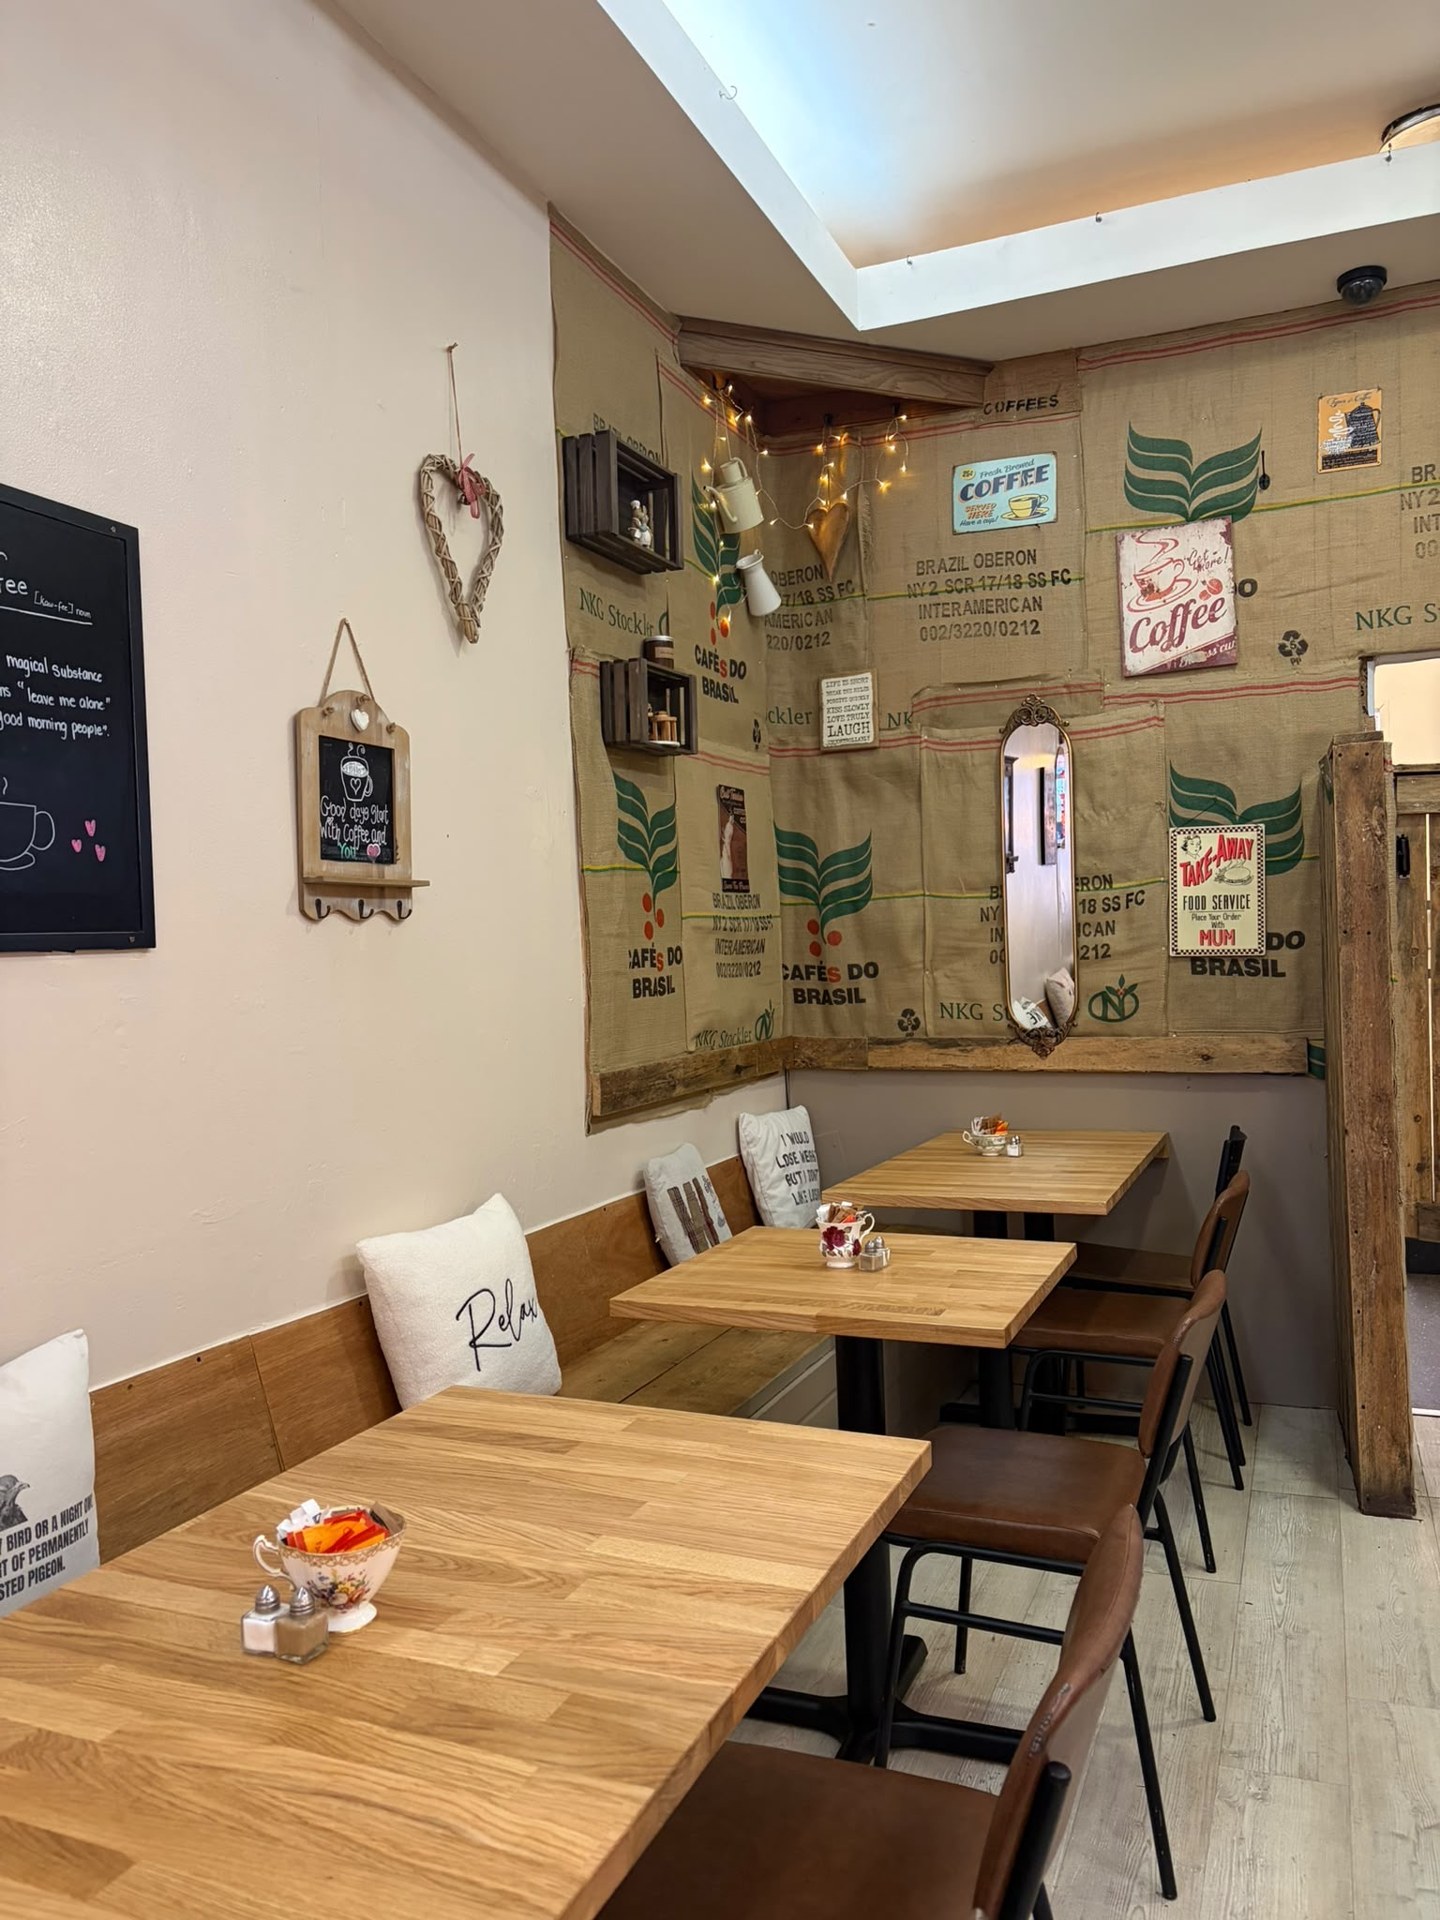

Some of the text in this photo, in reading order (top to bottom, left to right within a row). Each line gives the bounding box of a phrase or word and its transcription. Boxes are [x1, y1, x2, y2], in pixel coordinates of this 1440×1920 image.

[983, 395, 1059, 415] COFFEES
[980, 468, 1001, 479] Fresh
[1003, 459, 1034, 473] Brewed
[959, 464, 1050, 502] COFFEE
[916, 549, 1037, 576] BRAZIL OBERON
[770, 564, 823, 587] OBERON
[944, 576, 975, 596] SCR
[977, 572, 1023, 592] 17/18
[1027, 572, 1047, 589] SS
[1050, 568, 1072, 587] FC
[816, 585, 835, 602] SS
[837, 579, 855, 597] FC
[918, 596, 1043, 620] INTERAMERICAN
[1355, 603, 1440, 631] NKG S
[919, 619, 1041, 642] 002/3220/0212
[1130, 597, 1228, 654] Coffee
[6, 654, 48, 678] magical
[729, 658, 747, 680] DO
[702, 675, 739, 704] BRASIL
[59, 696, 76, 708] me
[826, 703, 870, 714] KISS SLOWLY
[766, 706, 812, 725] ckler
[827, 712, 870, 723] LOVE TRULY
[28, 717, 67, 740] morning
[827, 721, 870, 737] LAUGH
[320, 795, 346, 822] Good
[343, 823, 370, 851] Coffee
[371, 825, 387, 846] and
[340, 843, 356, 859] You
[1179, 834, 1254, 887] TAKE-AWAY
[1102, 895, 1121, 913] SS
[1125, 890, 1145, 909] FC
[1183, 894, 1251, 911] FOOD SERVICE
[1191, 912, 1242, 922] Place Your Order
[1211, 921, 1225, 929] With
[1199, 928, 1236, 947] MUM
[1266, 930, 1306, 950] DO
[667, 945, 683, 966] DO
[847, 961, 879, 981] DO
[1190, 958, 1286, 978] BRASIL
[633, 975, 676, 999] BRASIL
[792, 987, 866, 1005] BRASIL
[940, 1002, 983, 1020] NKG
[775, 1152, 800, 1169] LOSE
[785, 1171, 802, 1187] BUT
[456, 1278, 538, 1372] Relax
[6, 1527, 32, 1552] BIRD
[35, 1519, 49, 1539] OR
[51, 1514, 58, 1532] A
[60, 1500, 83, 1528] NIGHT
[12, 1552, 25, 1572] OF
[28, 1518, 89, 1565] PERMANENTLY
[28, 1555, 65, 1588] PIGEON.
